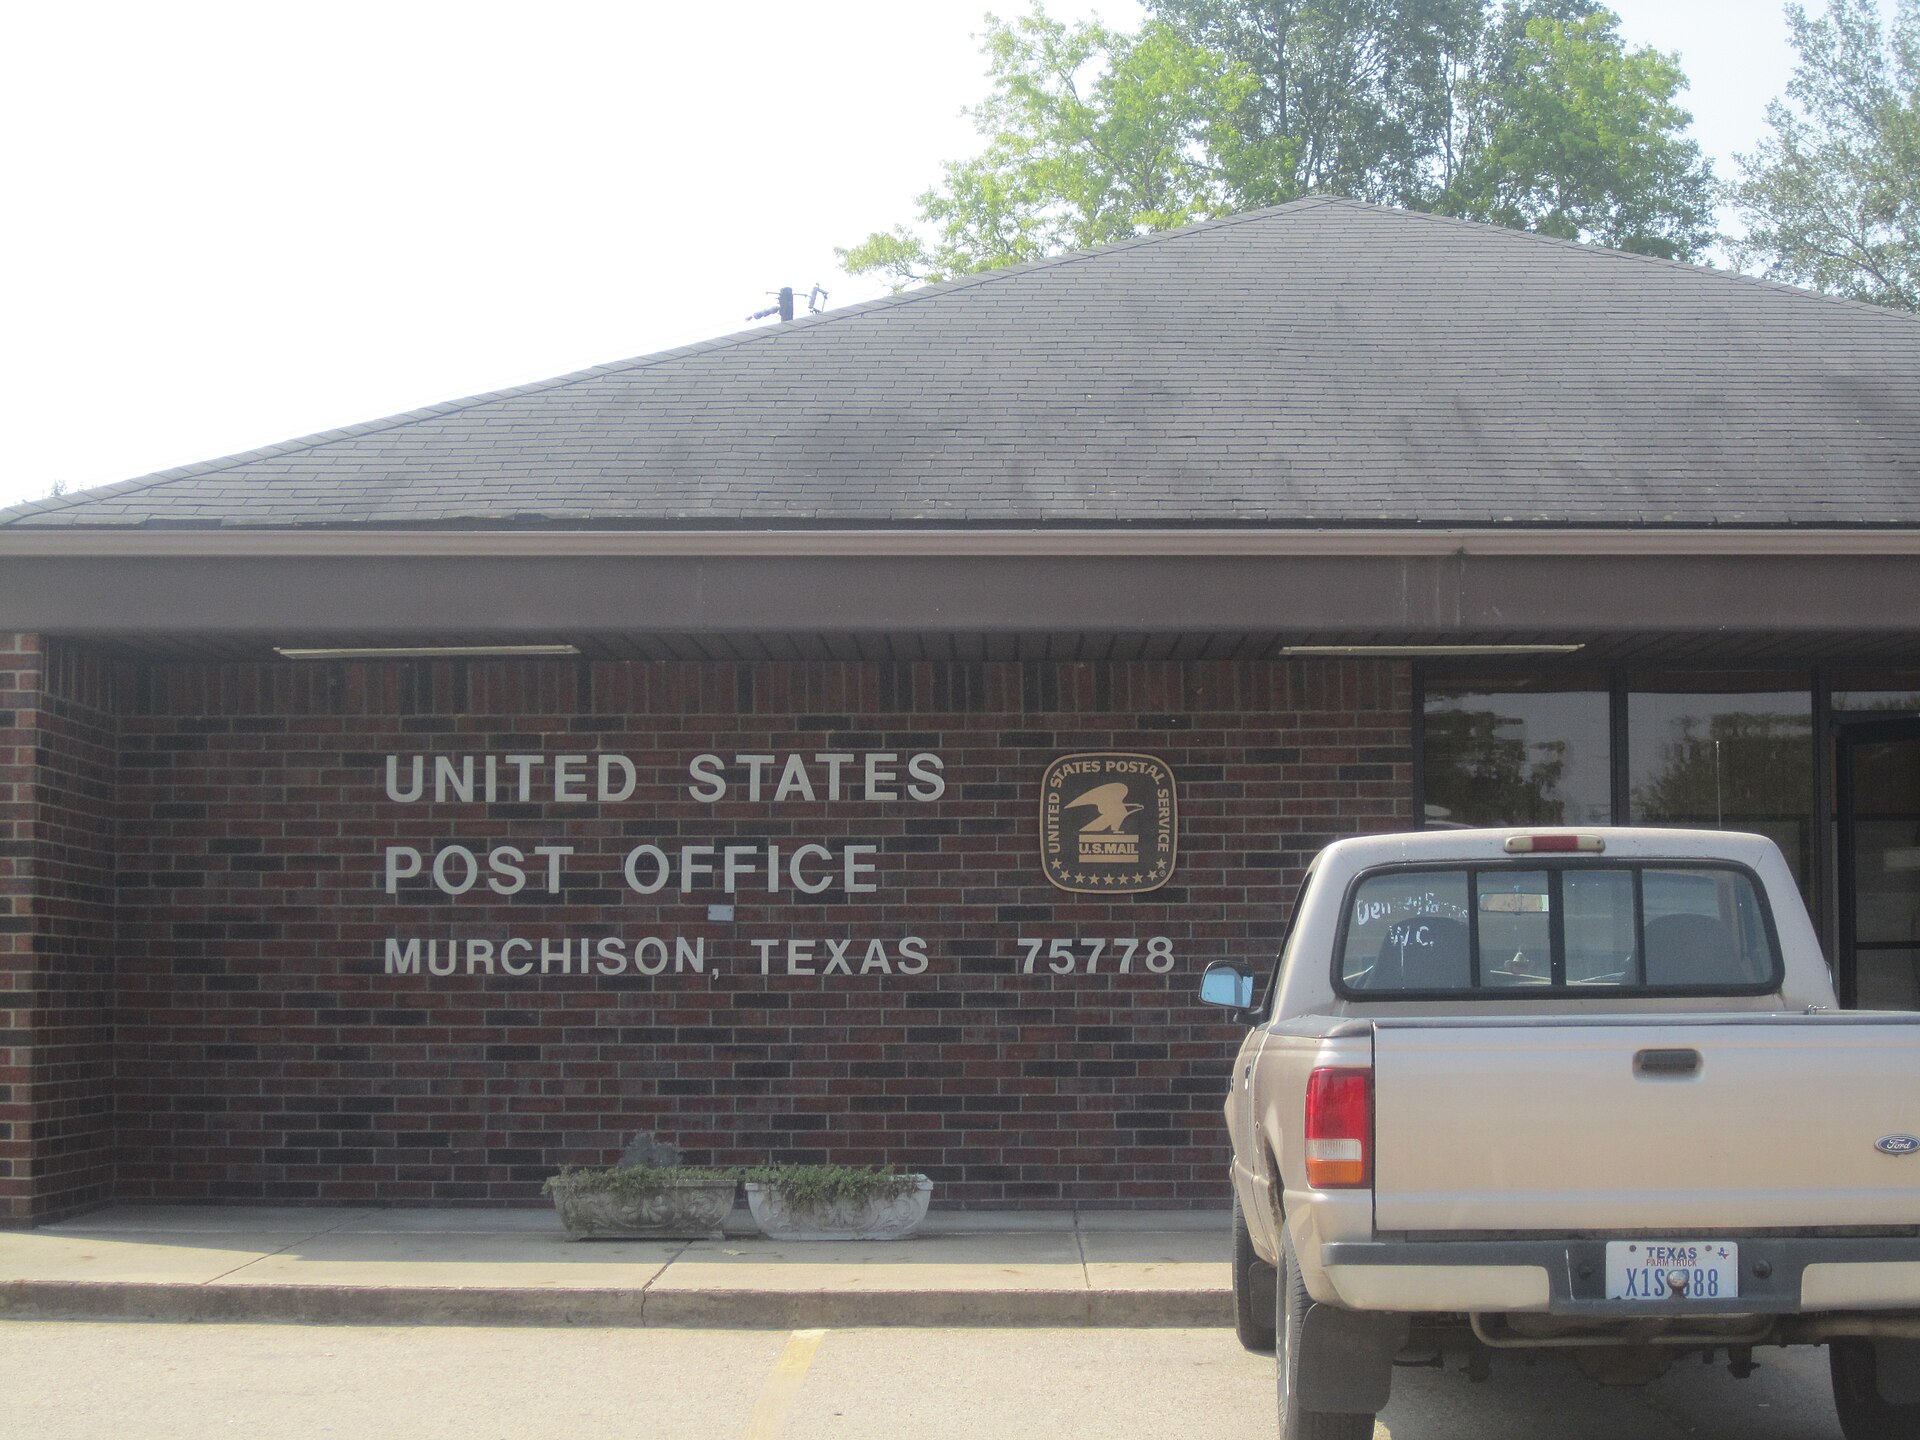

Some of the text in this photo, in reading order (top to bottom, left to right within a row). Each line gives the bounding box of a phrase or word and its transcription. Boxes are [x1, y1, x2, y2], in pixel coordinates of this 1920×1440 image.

[385, 752, 946, 803] UNITED STATES
[1047, 760, 1170, 854] UNITED STATES POSTAL SERVICE
[385, 844, 877, 895] POST OFFICE
[385, 936, 1175, 980] MURCHISON, TEXAS 75778
[1886, 1138, 1912, 1149] Ford
[1646, 1246, 1697, 1260] TEXAS
[1646, 1259, 1697, 1267] FARM TRUCK
